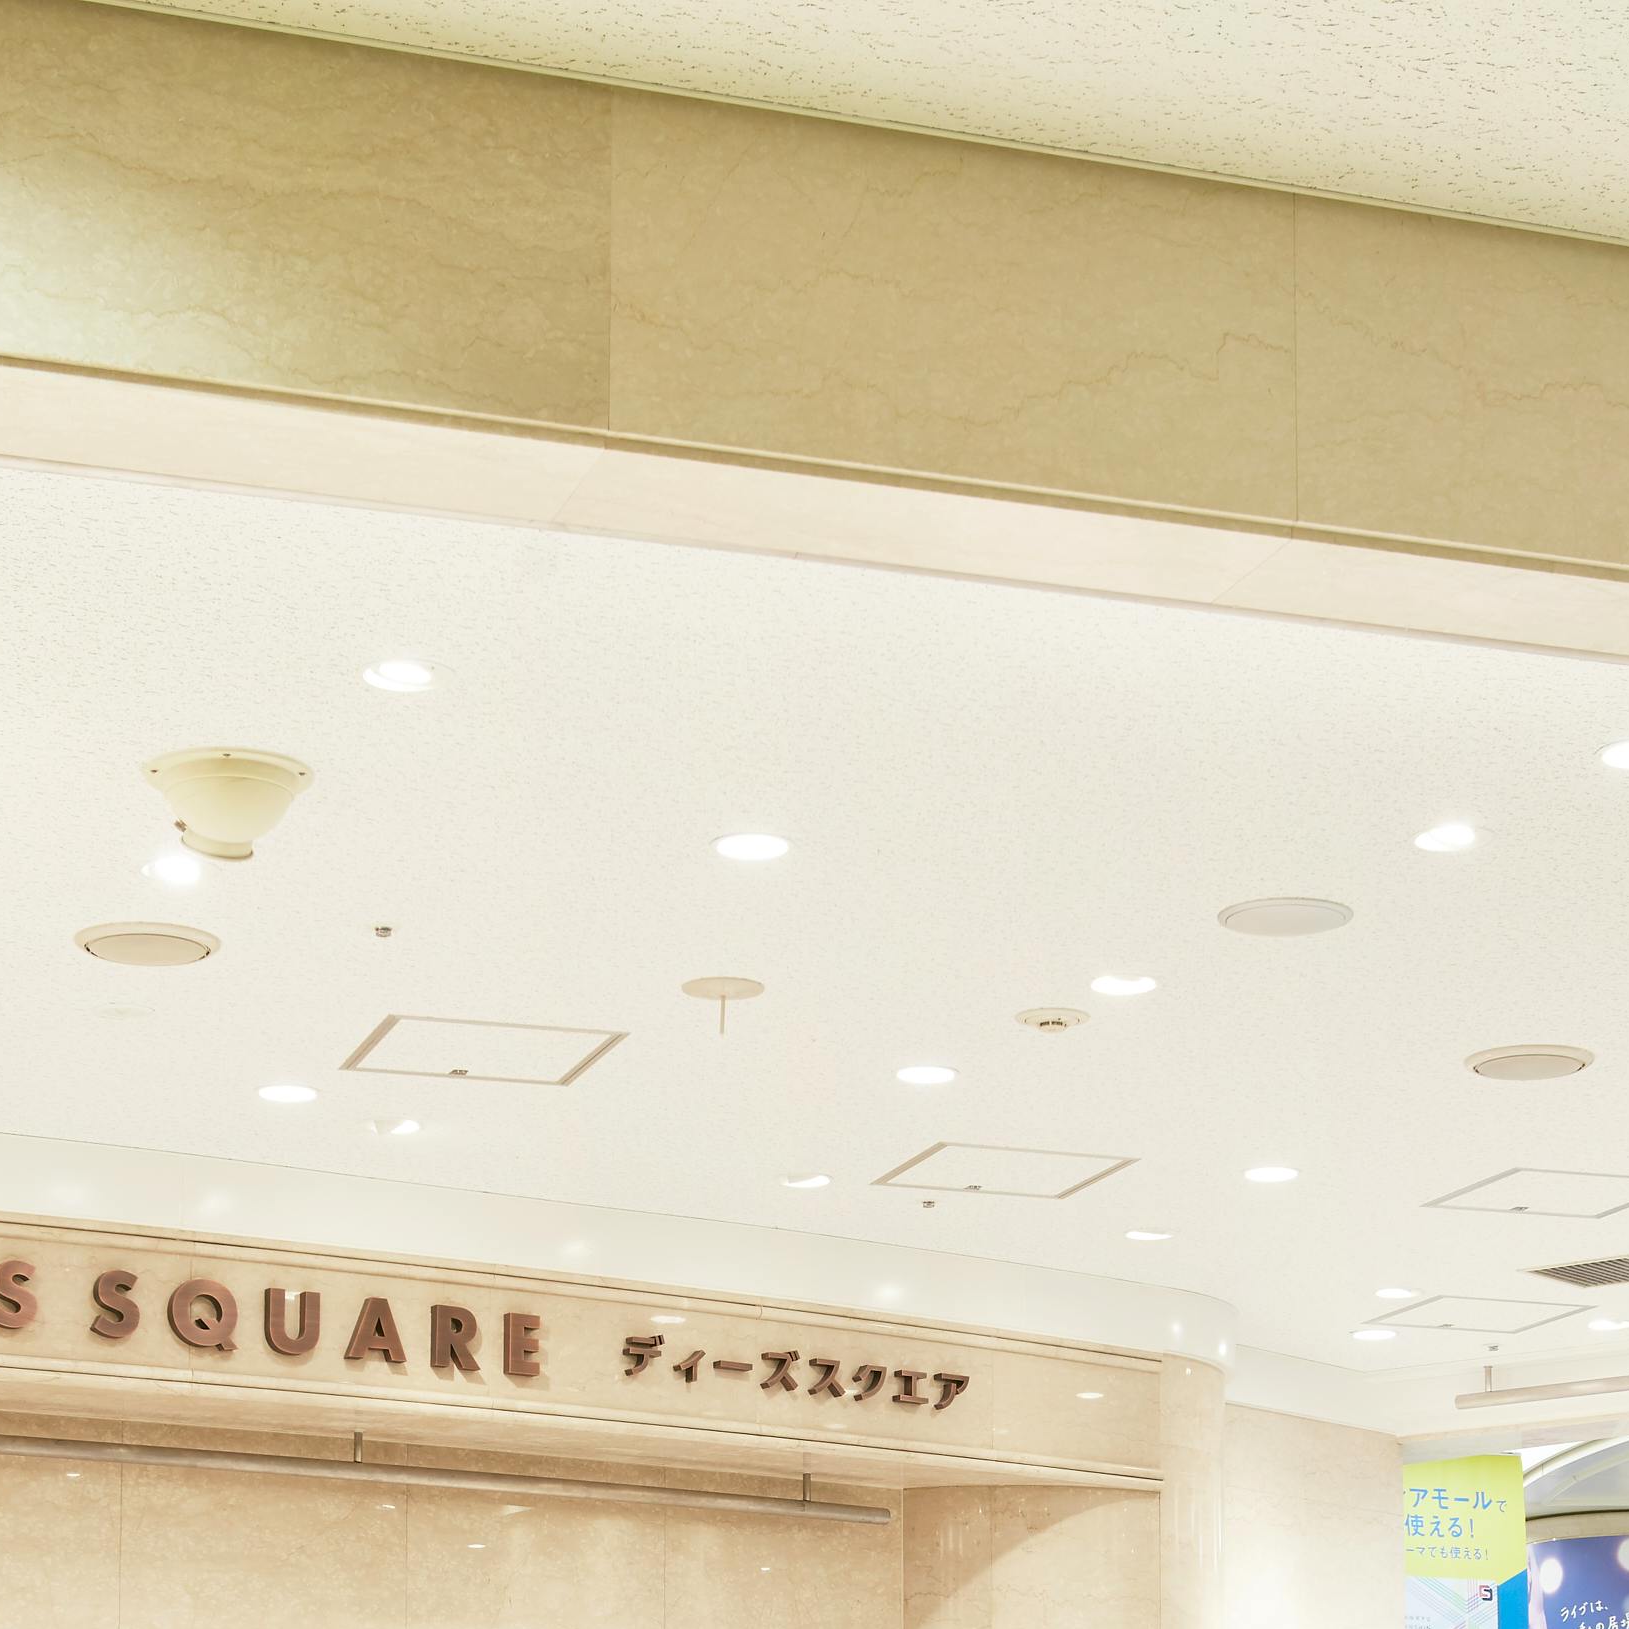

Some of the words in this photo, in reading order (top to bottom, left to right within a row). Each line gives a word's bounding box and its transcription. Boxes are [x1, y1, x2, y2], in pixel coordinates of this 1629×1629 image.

[89, 1269, 542, 1377] SQUARE
[621, 1333, 971, 1411] ディーズスクエア
[1403, 1486, 1508, 1513] アモールで
